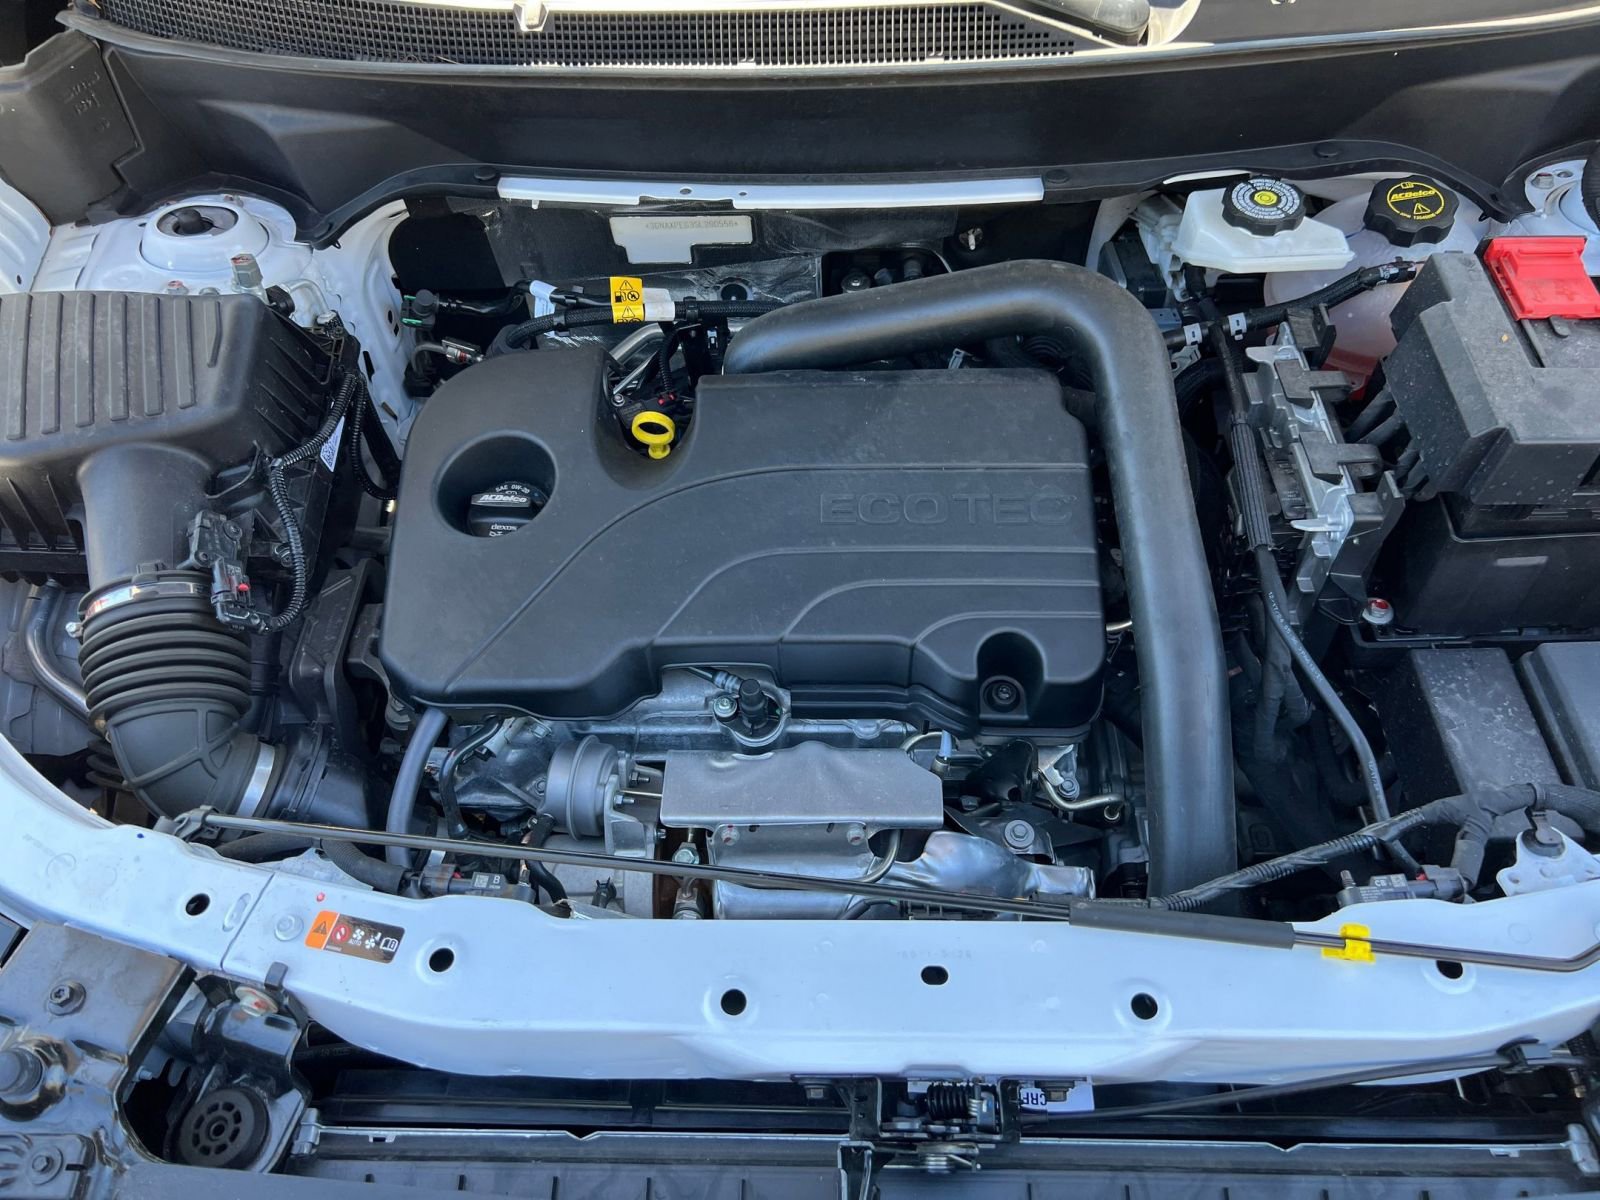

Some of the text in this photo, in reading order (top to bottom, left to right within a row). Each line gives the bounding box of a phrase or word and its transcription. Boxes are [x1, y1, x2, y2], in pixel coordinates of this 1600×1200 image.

[1390, 189, 1437, 201] ACDelco
[495, 484, 531, 494] SAE 0W-20
[479, 494, 528, 503] ACDelco
[819, 492, 1074, 525] ECOTEC
[492, 875, 501, 885] B
